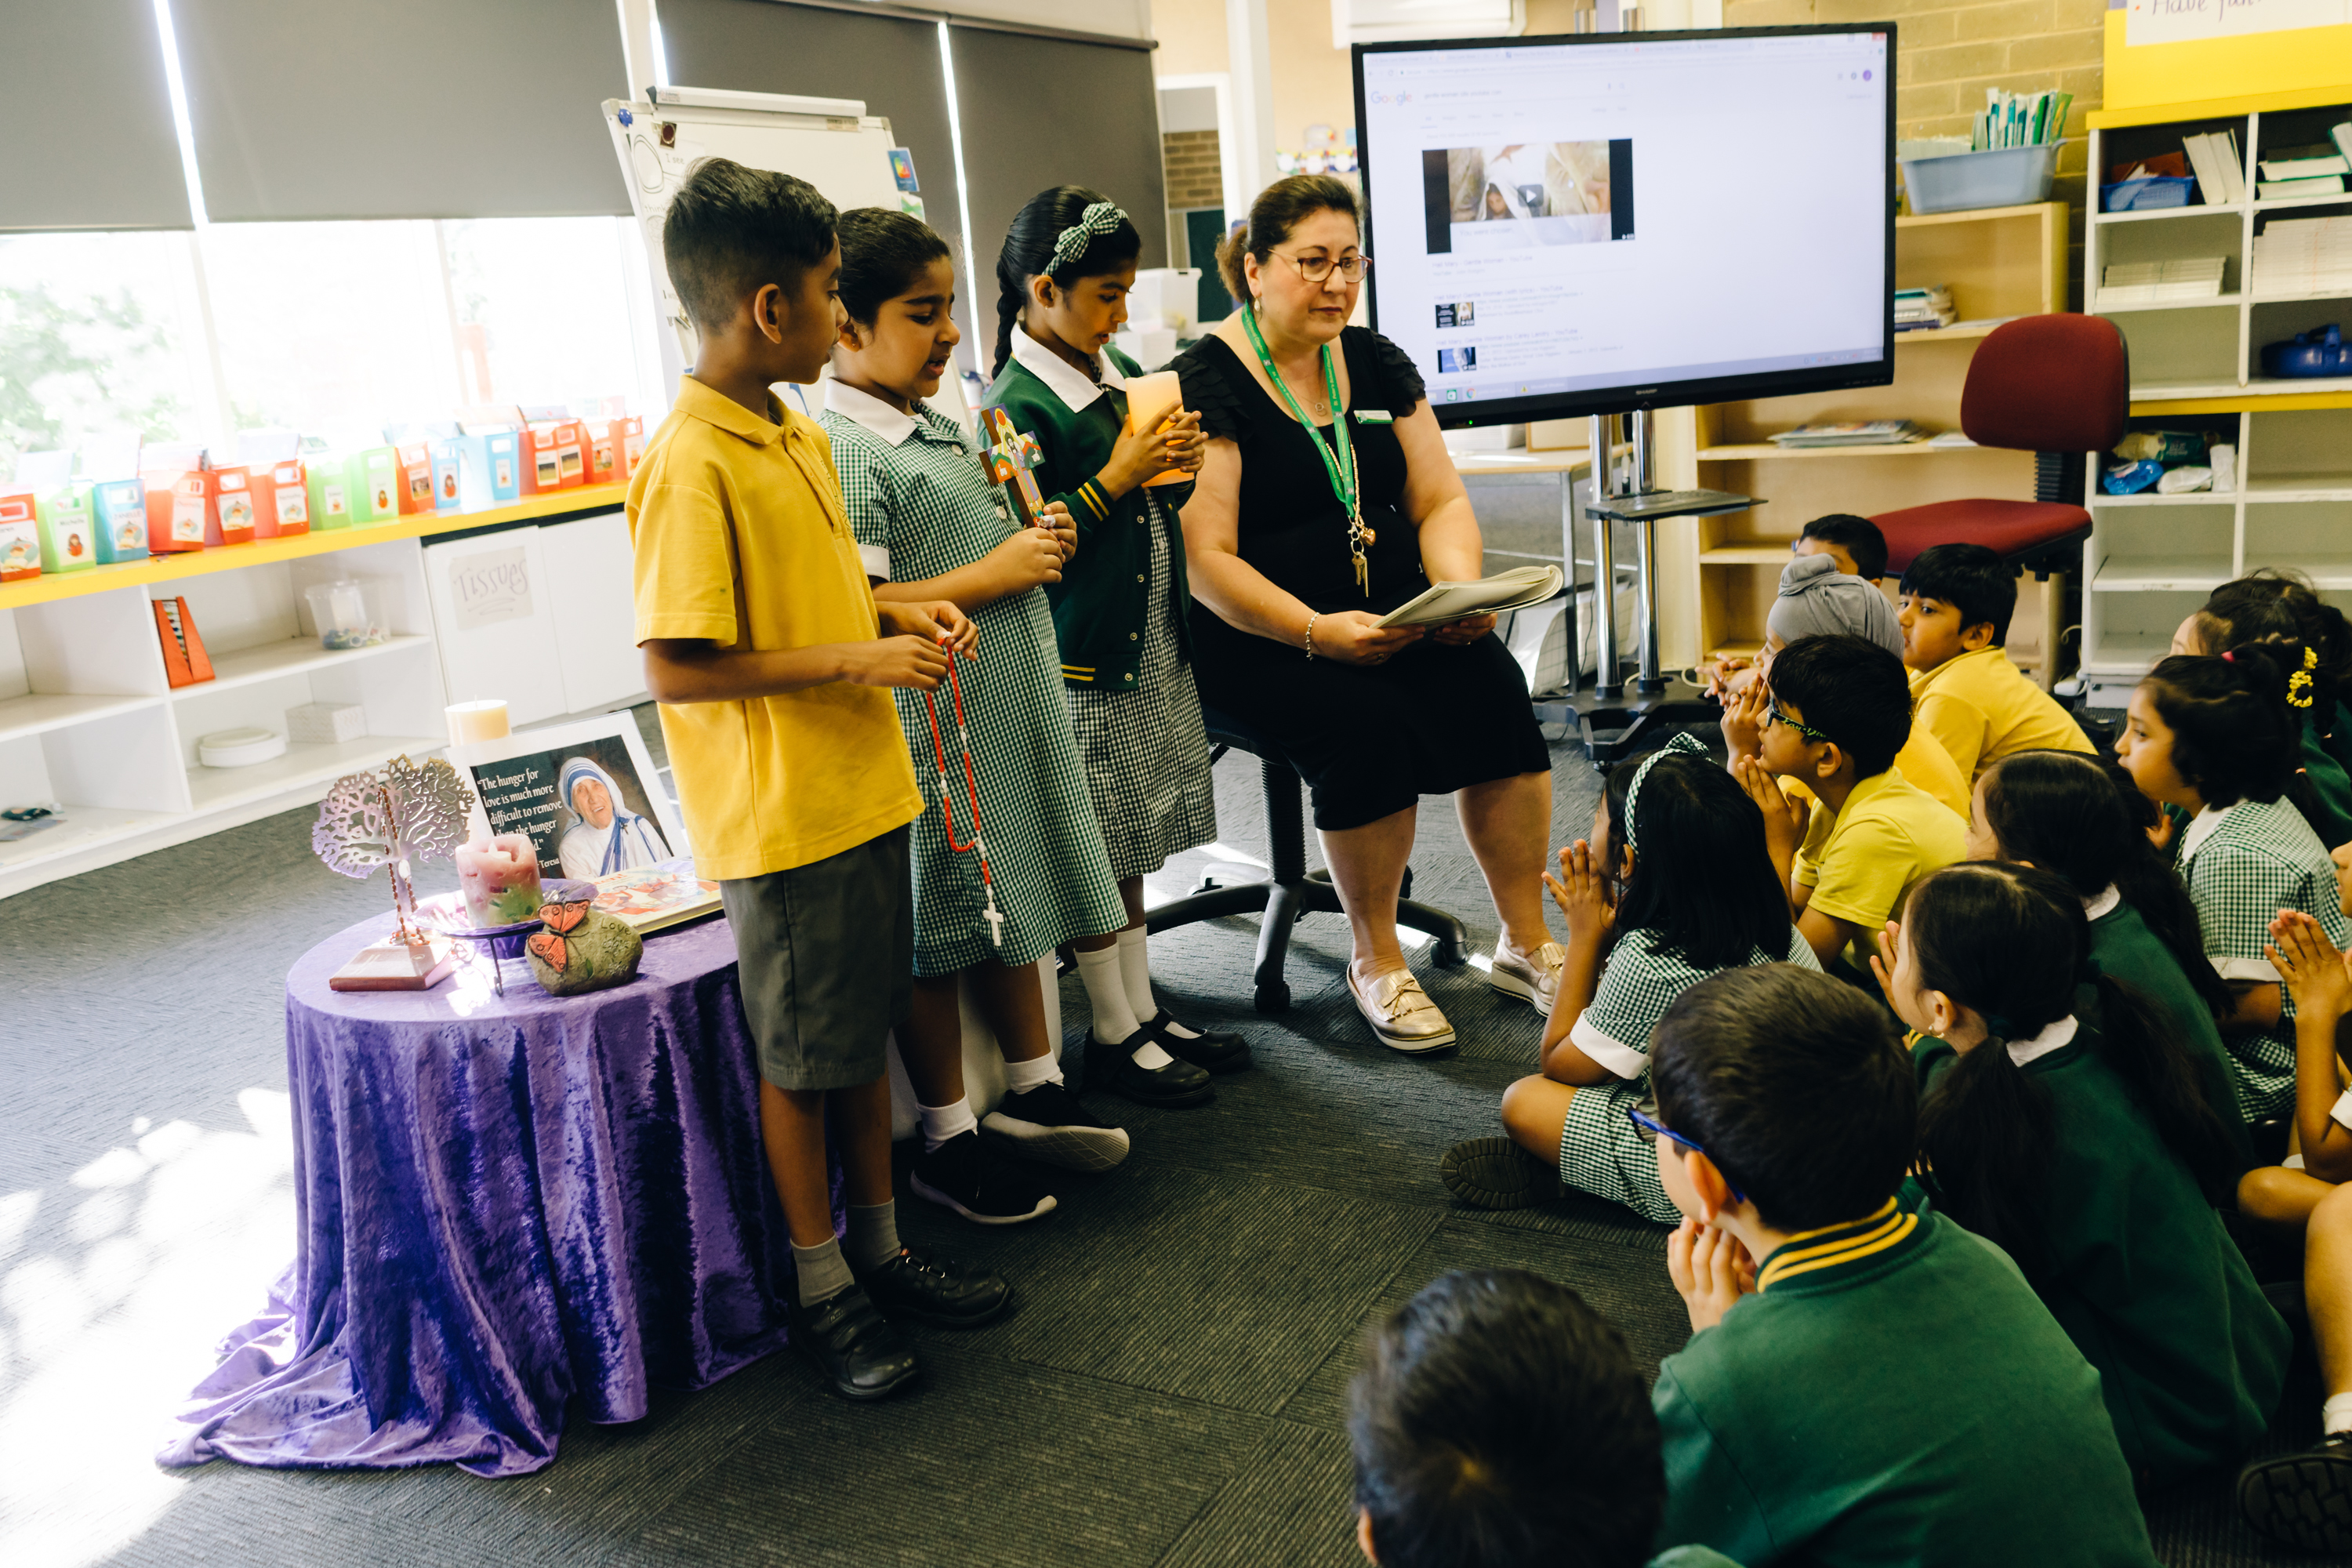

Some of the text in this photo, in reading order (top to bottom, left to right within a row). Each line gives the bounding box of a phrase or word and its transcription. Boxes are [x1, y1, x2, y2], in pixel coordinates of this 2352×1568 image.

[1370, 89, 1413, 106] Google
[496, 773, 526, 787] hunger
[526, 768, 539, 784] for
[482, 785, 554, 808] love is much more
[490, 800, 563, 827] difficult to remove
[515, 824, 530, 835] the
[528, 819, 557, 834] hunger
[539, 858, 561, 869] Teresa
[601, 917, 632, 935] Love
